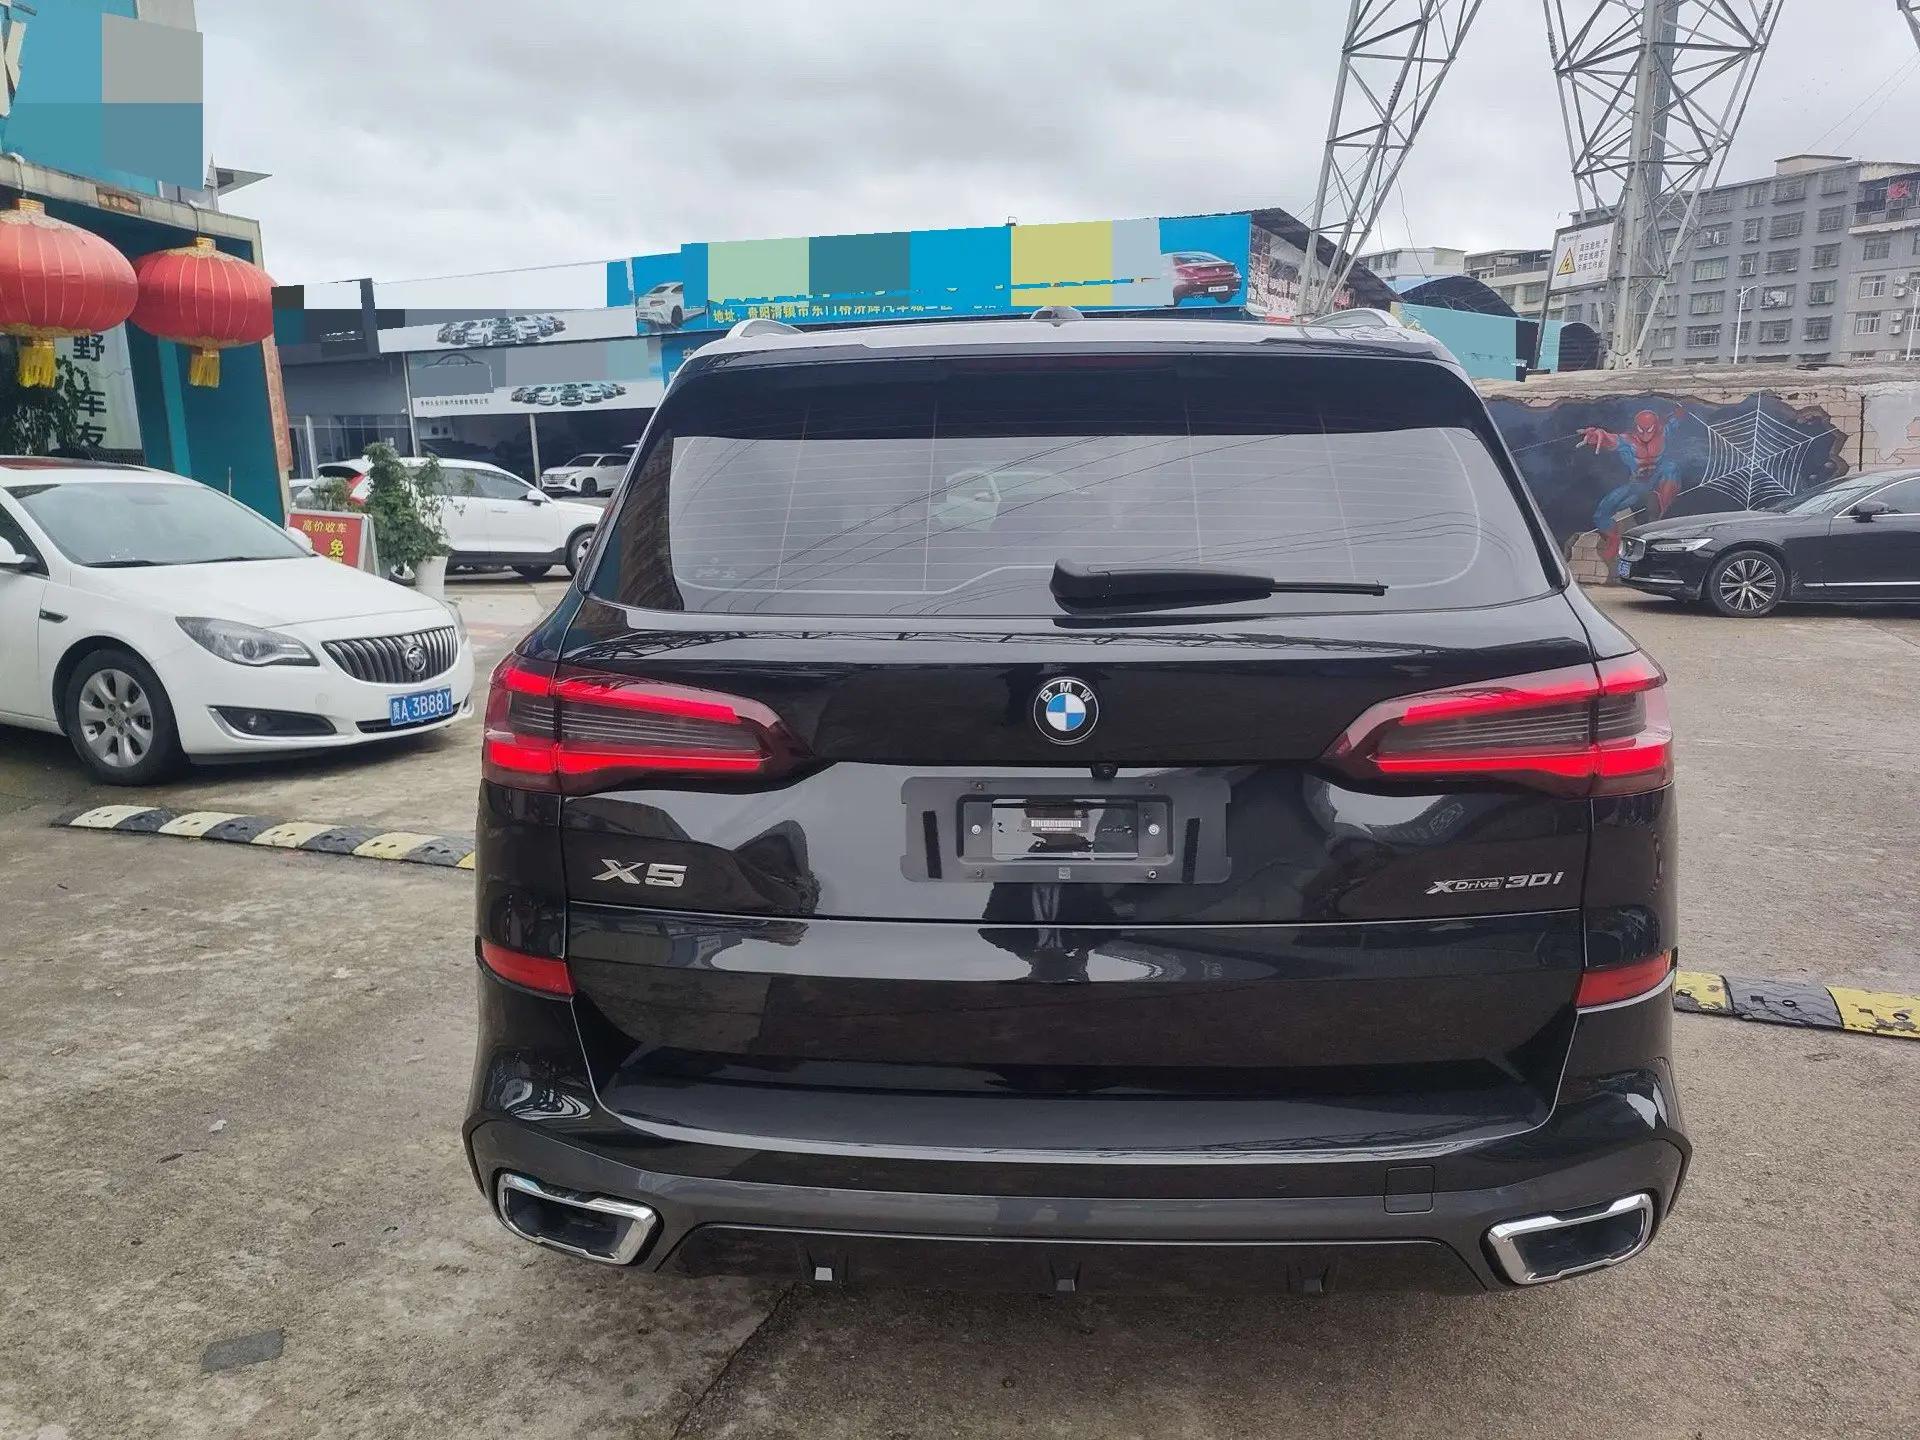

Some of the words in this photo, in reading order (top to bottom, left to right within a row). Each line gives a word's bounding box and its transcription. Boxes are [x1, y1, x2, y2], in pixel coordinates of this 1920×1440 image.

[303, 520, 347, 533] 高价收车
[1040, 682, 1093, 703] BMW
[592, 859, 688, 888] X5
